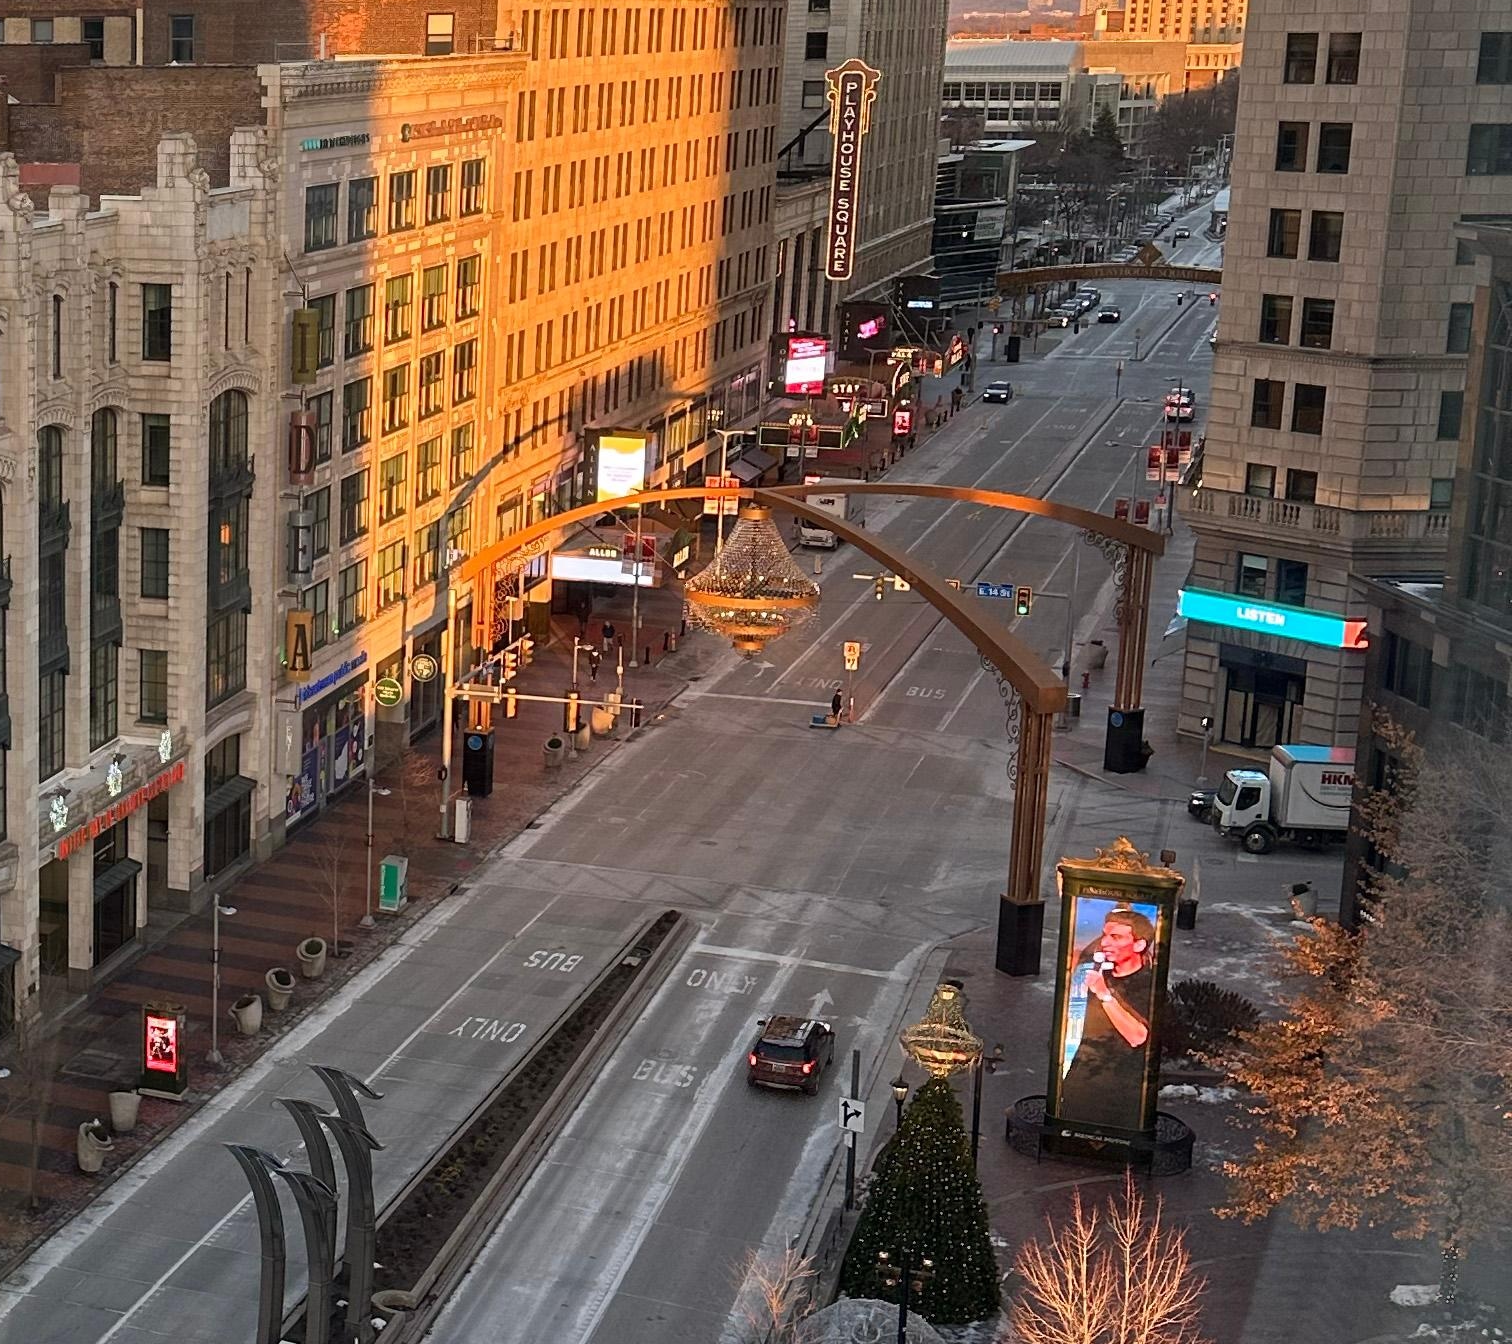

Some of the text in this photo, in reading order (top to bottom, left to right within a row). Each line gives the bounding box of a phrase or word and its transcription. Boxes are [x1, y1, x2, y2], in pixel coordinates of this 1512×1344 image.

[834, 82, 857, 272] PLAYHOUSE SQUARE
[1236, 607, 1286, 627] LISTEN
[906, 686, 946, 700] BUS
[523, 950, 584, 974] BUS
[686, 968, 758, 995] ONLY
[447, 1016, 527, 1043] ONLY
[633, 1059, 698, 1088] BUS
